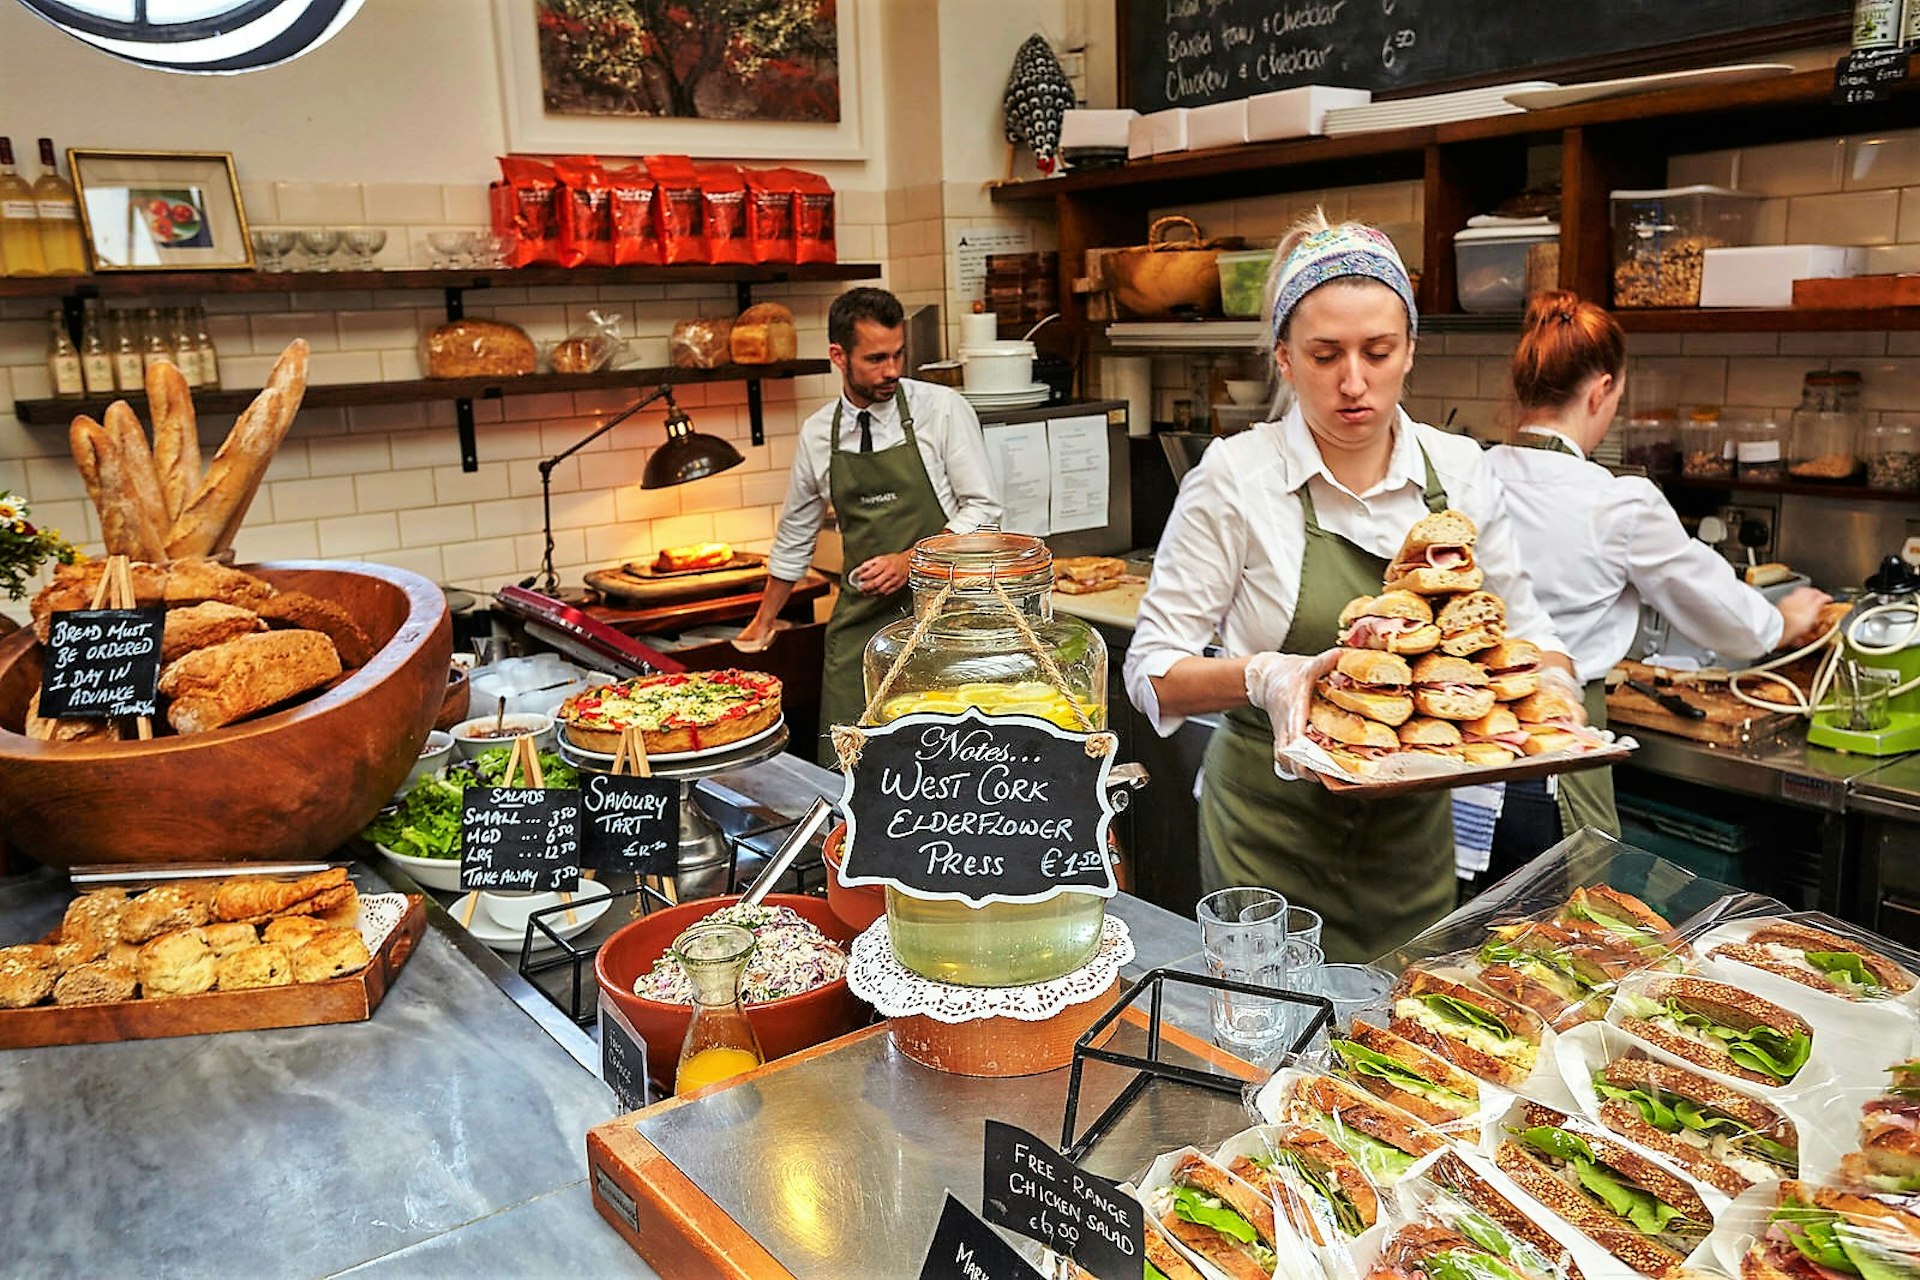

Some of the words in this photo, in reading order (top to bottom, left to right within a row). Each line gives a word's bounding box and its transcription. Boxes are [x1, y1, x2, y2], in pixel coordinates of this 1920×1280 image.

[1272, 0, 1346, 36] Cheddar
[1166, 61, 1229, 101] Chicken
[1256, 43, 1333, 82] Cheddar
[51, 620, 102, 648] BREAD
[106, 620, 153, 640] MUST
[55, 646, 78, 669] BE
[86, 637, 154, 660] ORDERED
[69, 668, 105, 688] DAY
[108, 661, 133, 682] IN
[489, 788, 546, 805] SALADS
[463, 807, 521, 826] SMALL
[465, 846, 493, 868] LRG
[1014, 1143, 1056, 1182] FREE
[1072, 1175, 1131, 1228] RANGE
[1009, 1172, 1082, 1223] CHICKEN
[1085, 1215, 1135, 1256] SALAD
